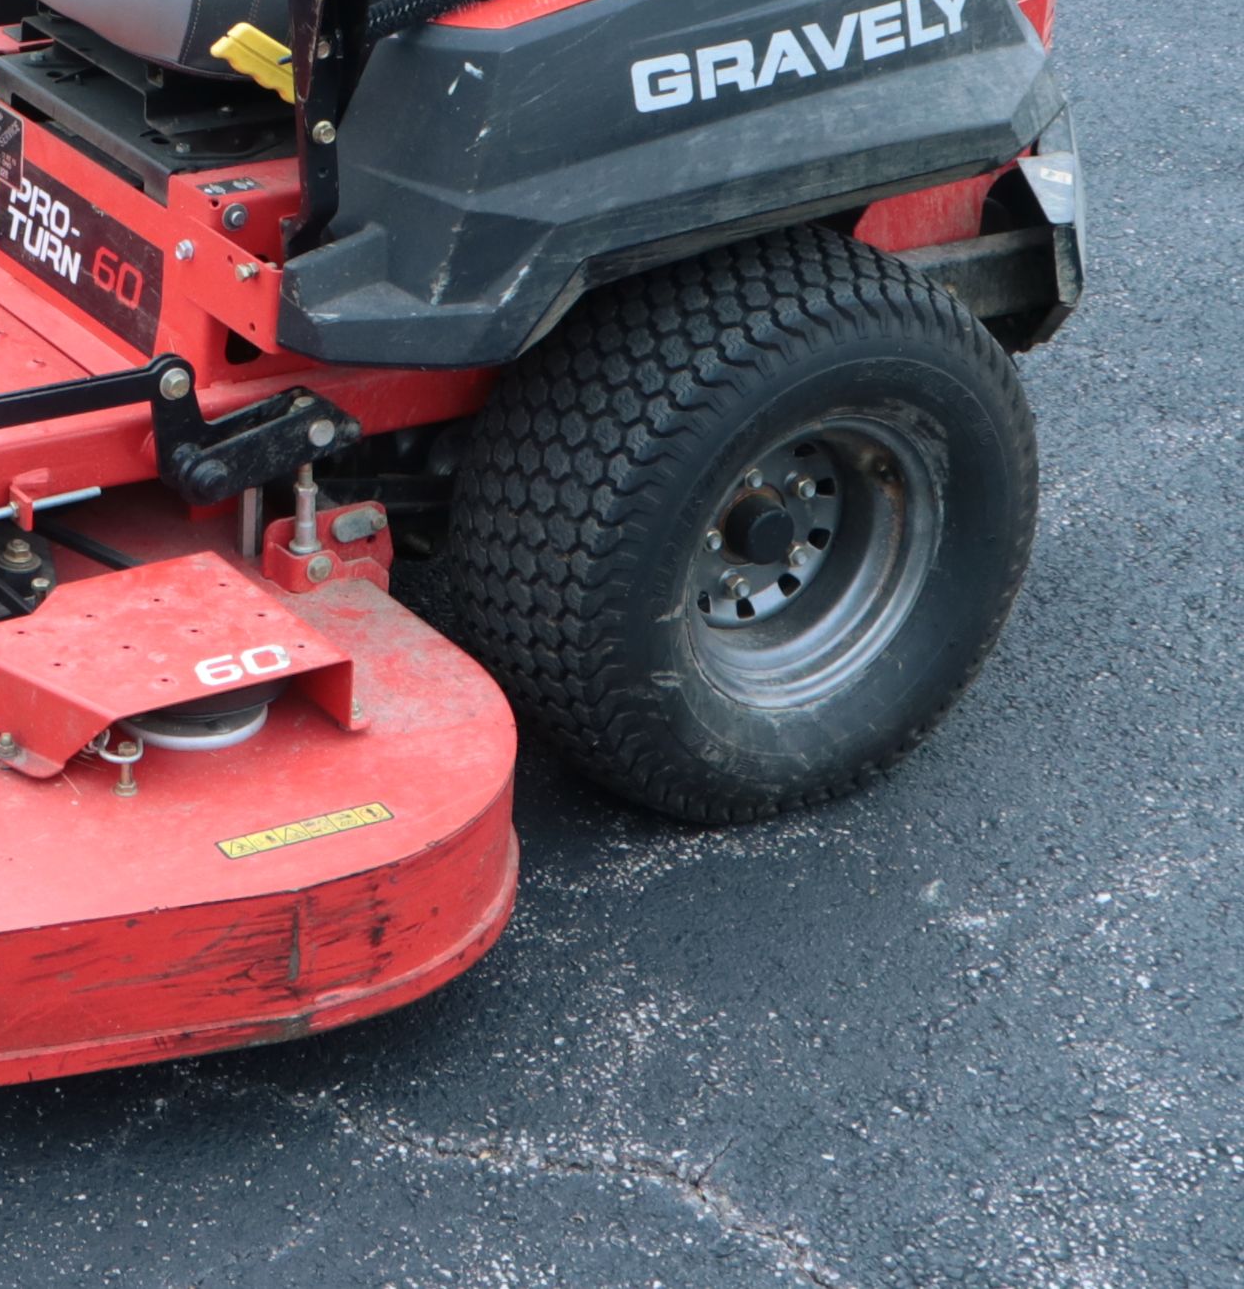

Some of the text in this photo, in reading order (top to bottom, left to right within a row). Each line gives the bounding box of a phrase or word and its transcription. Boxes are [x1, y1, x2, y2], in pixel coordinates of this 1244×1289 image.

[9, 176, 81, 238] PRO-
[7, 204, 144, 310] TURN 60
[194, 644, 292, 686] 60
